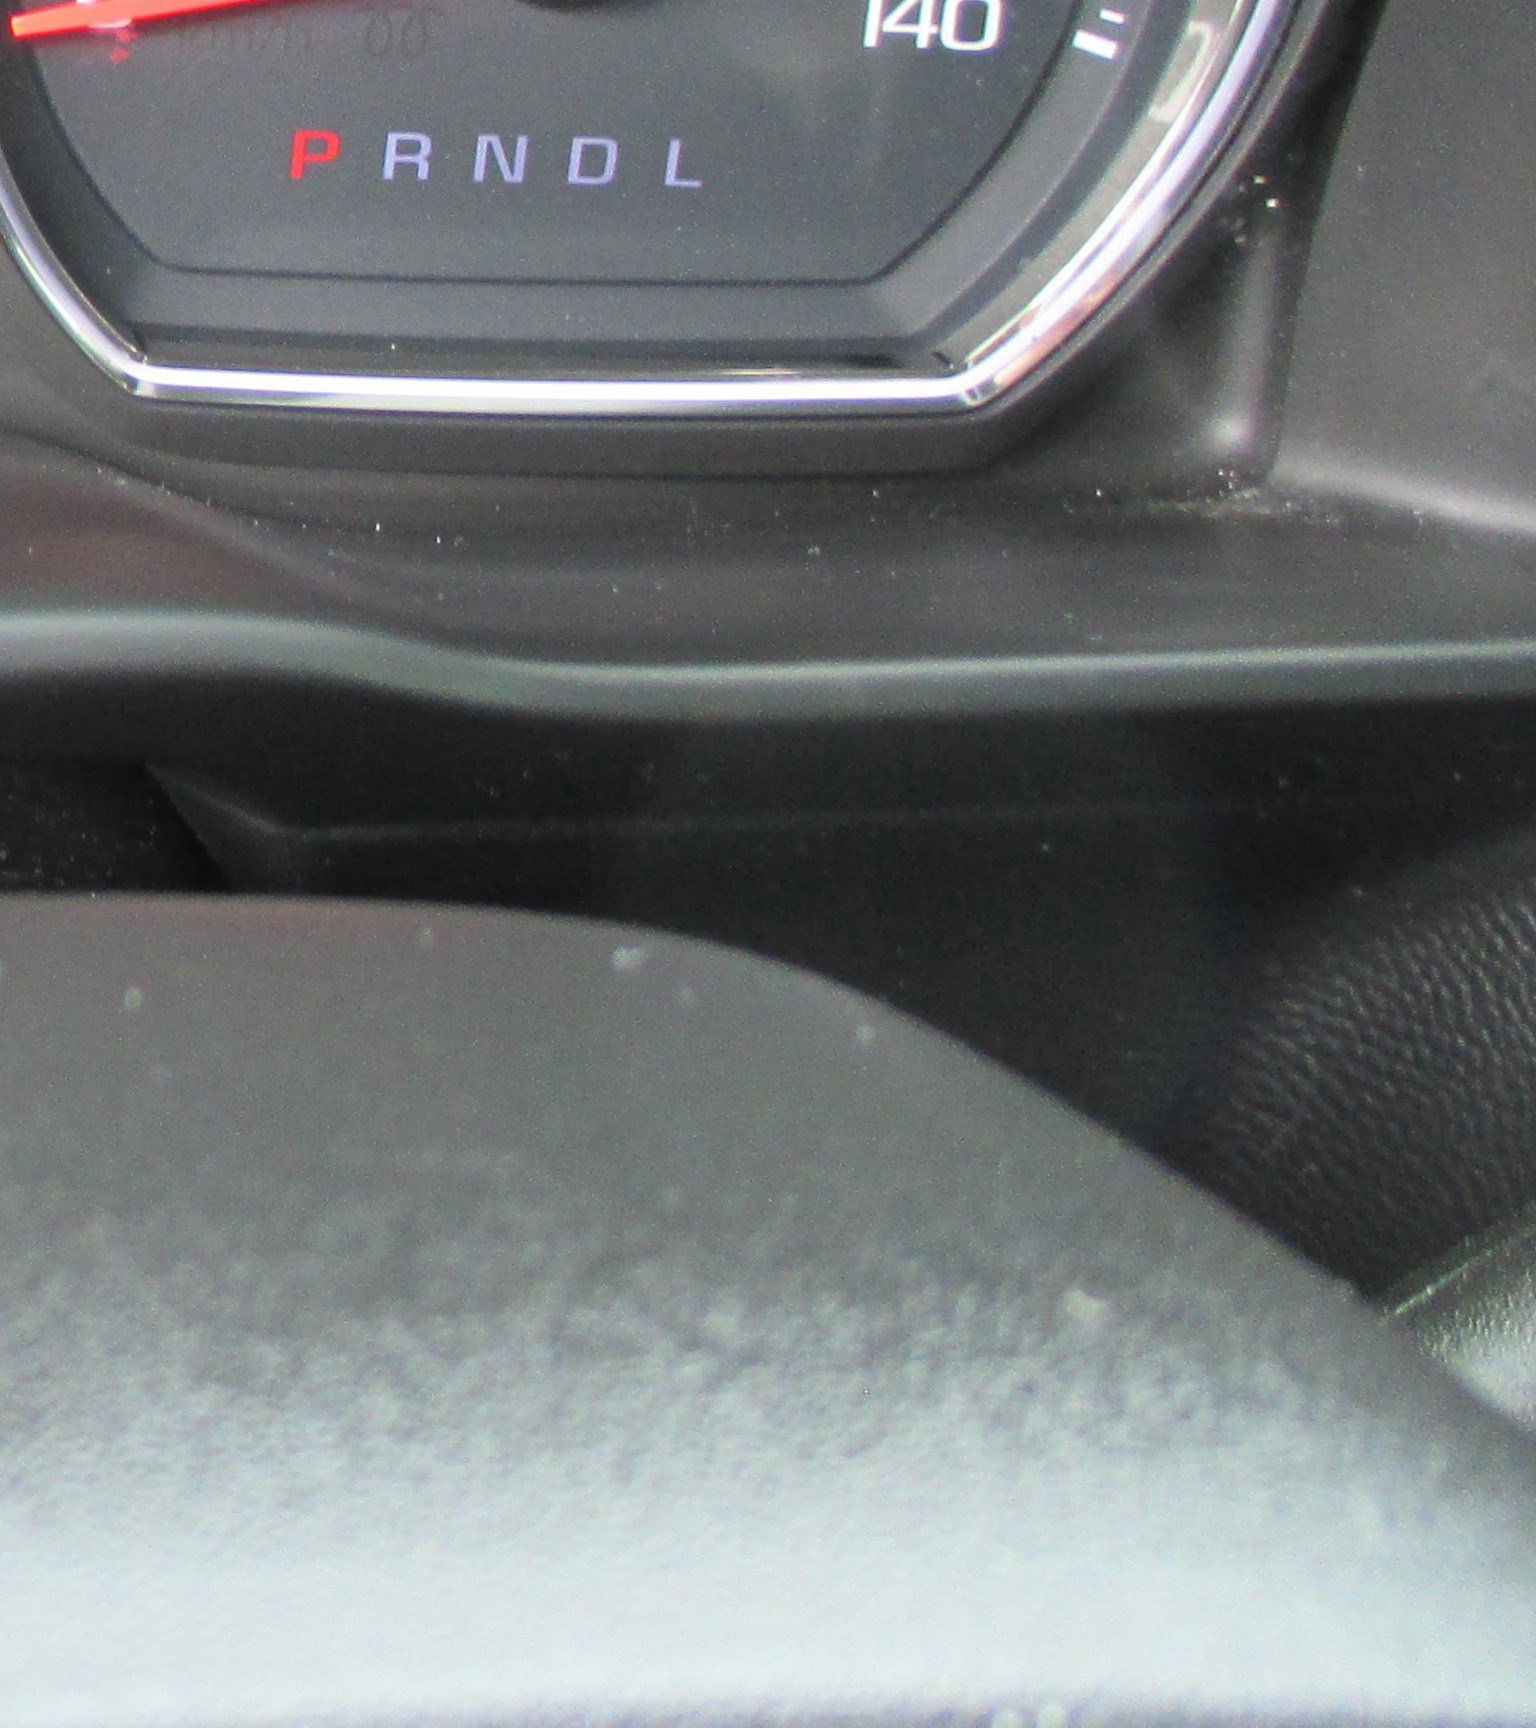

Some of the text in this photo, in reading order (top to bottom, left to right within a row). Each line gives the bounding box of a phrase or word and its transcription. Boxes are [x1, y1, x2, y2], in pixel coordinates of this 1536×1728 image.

[291, 130, 700, 187] P R N D L
